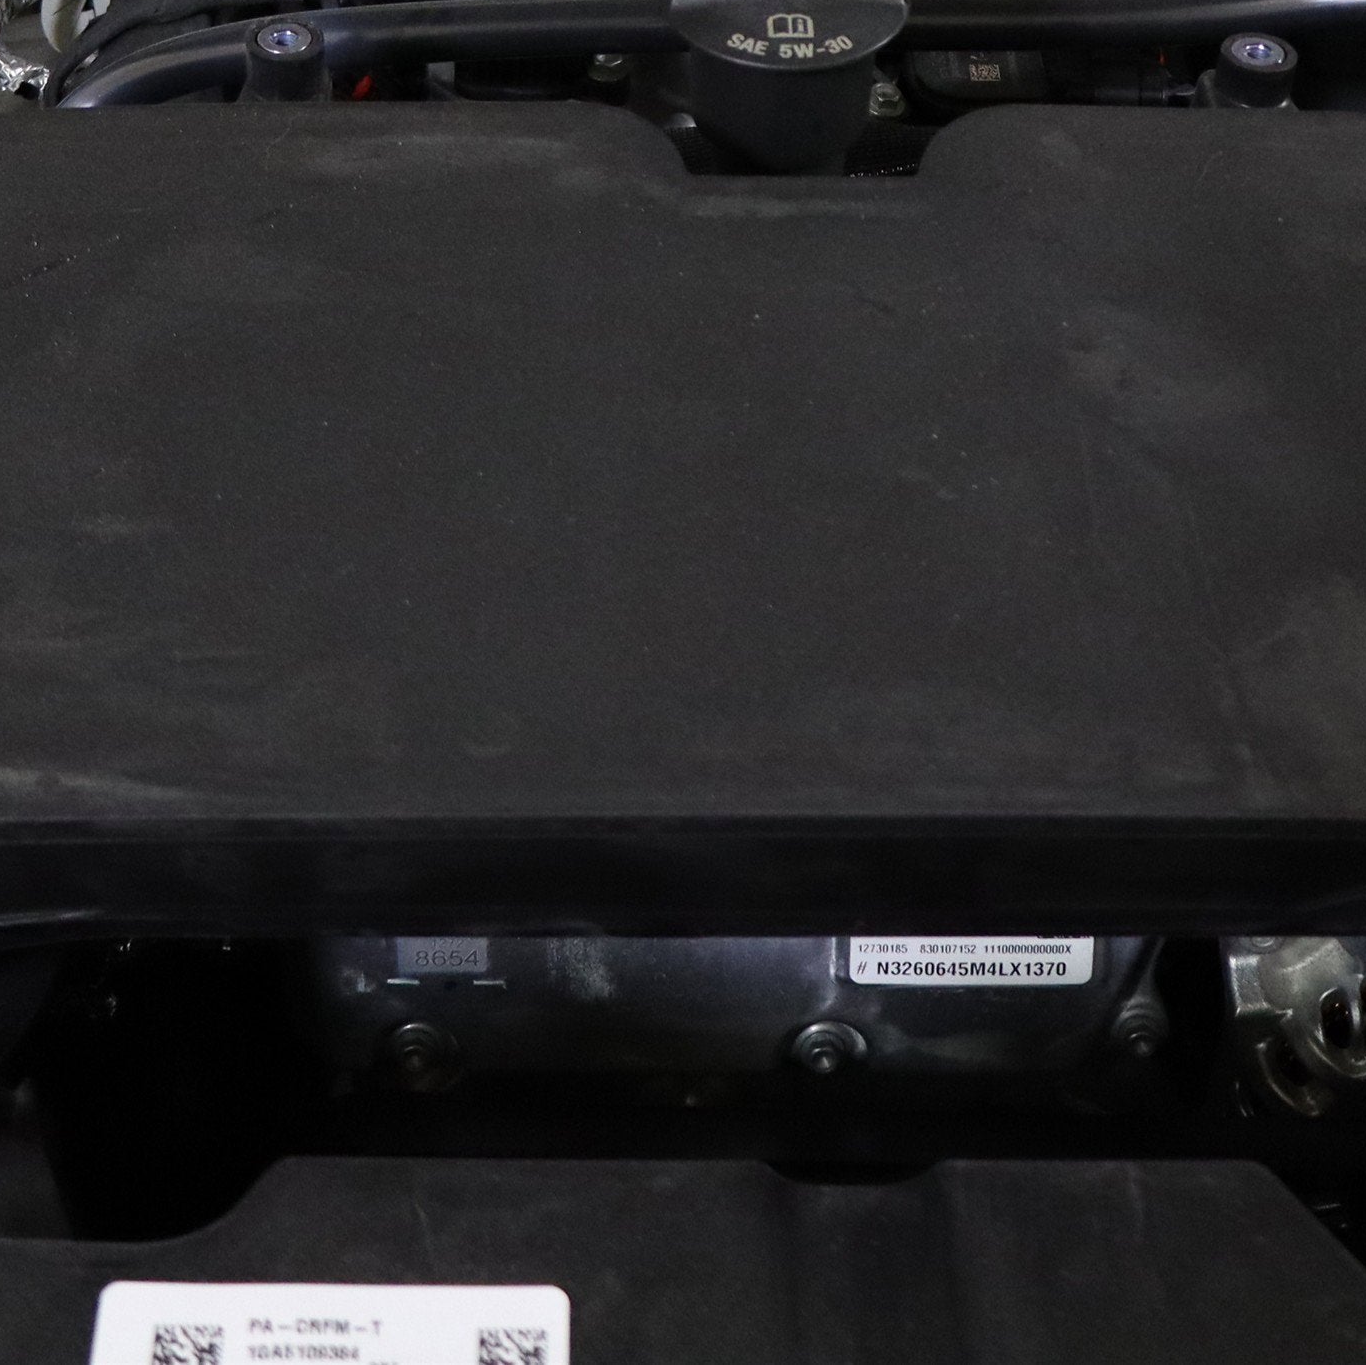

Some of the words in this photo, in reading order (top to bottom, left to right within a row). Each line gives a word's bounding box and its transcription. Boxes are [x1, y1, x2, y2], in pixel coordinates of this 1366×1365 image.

[727, 33, 769, 56] SAE
[779, 35, 854, 59] 5W-30
[858, 944, 908, 954] 12730185
[919, 944, 977, 954] 830107152
[415, 950, 480, 967] 8654
[876, 961, 1067, 977] N3260645M4LX1370
